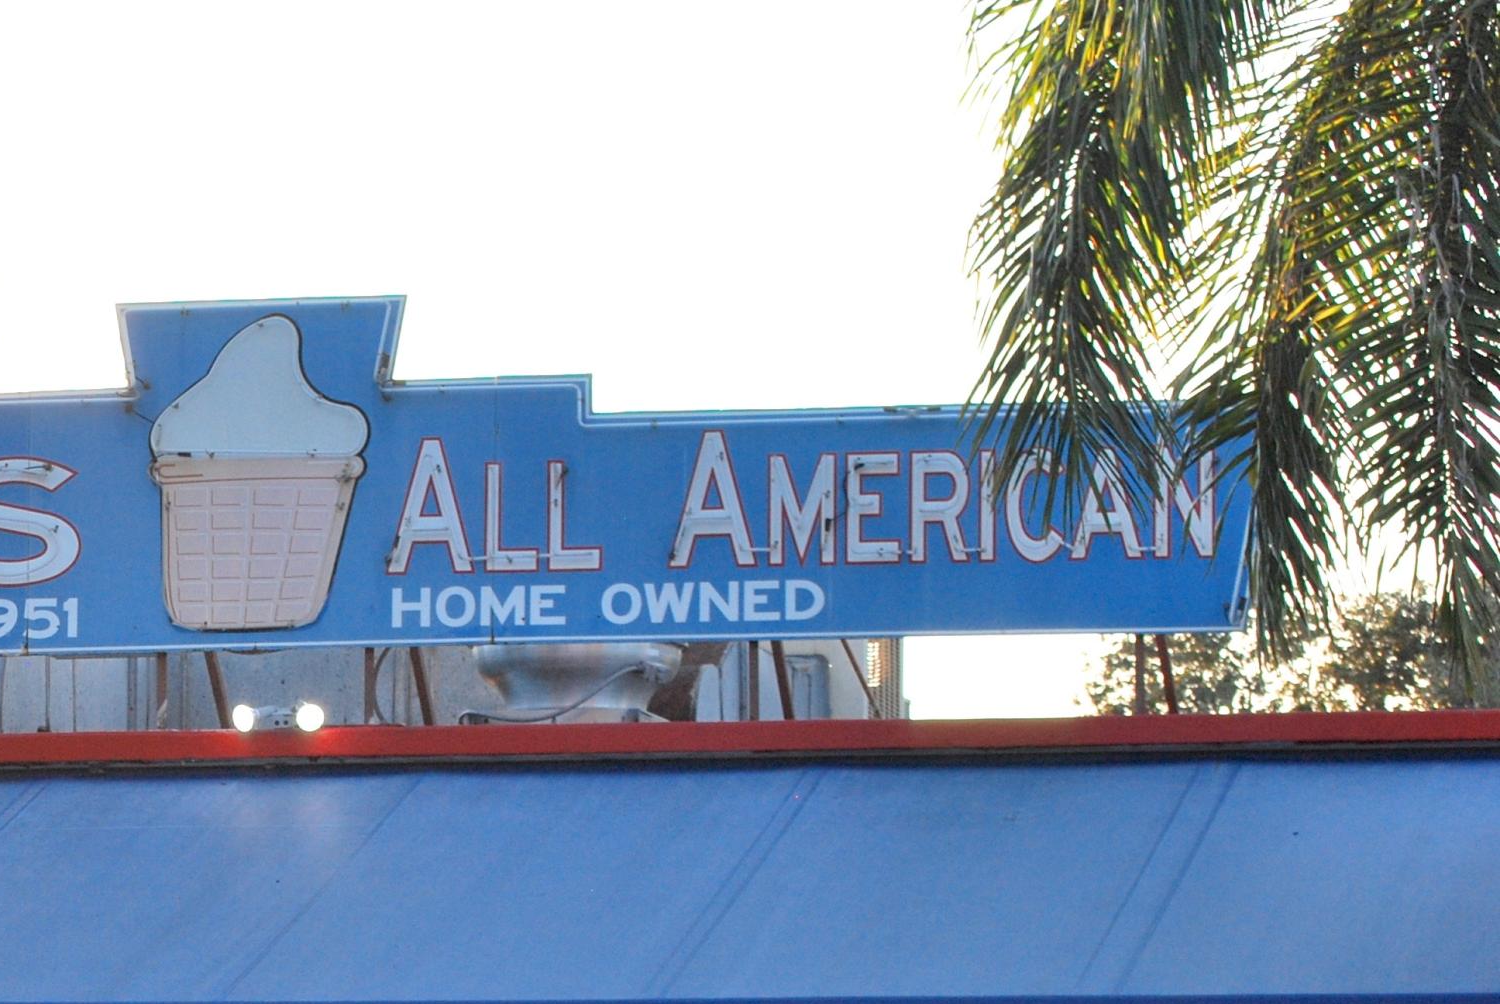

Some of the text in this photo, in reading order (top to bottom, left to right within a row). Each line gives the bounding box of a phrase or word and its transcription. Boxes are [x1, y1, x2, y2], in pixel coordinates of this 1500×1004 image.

[385, 430, 1217, 575] ALL AMERICAN
[390, 578, 826, 629] HOME OWNED
